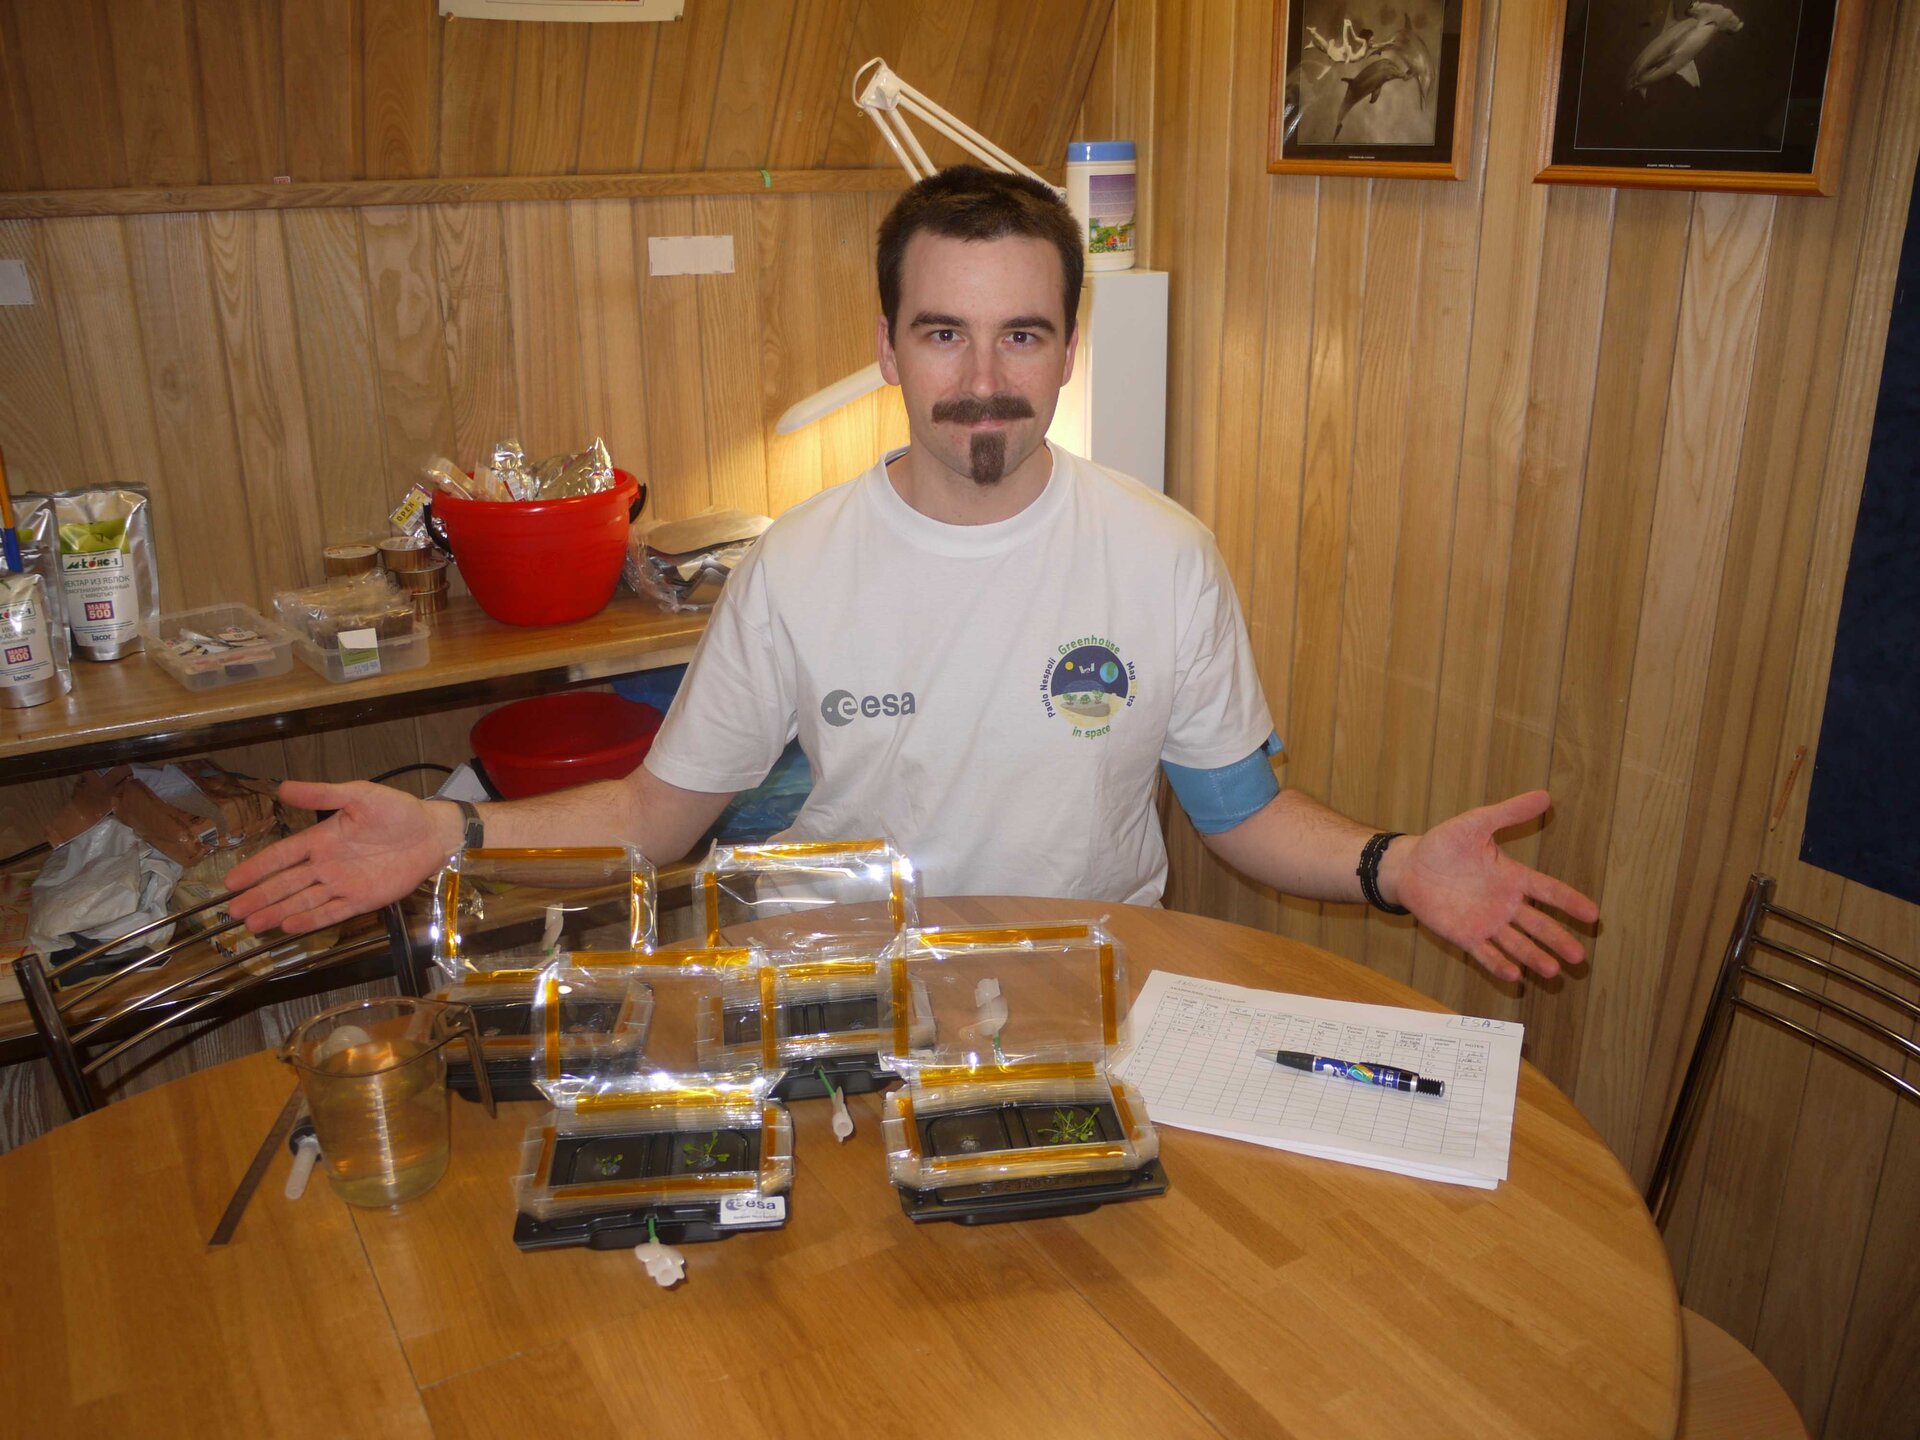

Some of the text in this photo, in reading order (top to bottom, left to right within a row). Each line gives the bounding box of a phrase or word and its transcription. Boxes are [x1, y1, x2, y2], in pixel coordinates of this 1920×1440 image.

[396, 501, 415, 522] OPEN
[91, 577, 102, 586] ИЗ
[103, 575, 130, 584] ЯБЛОК
[87, 602, 111, 611] MARS
[89, 609, 111, 620] 500
[1058, 634, 1120, 655] Greenhouse
[9, 652, 29, 663] 500
[1040, 657, 1056, 718] Paolo Nespoli
[861, 692, 916, 718] esa
[1072, 724, 1111, 740] in space
[1460, 1017, 1491, 1029] ESA
[745, 1200, 776, 1210] esa
